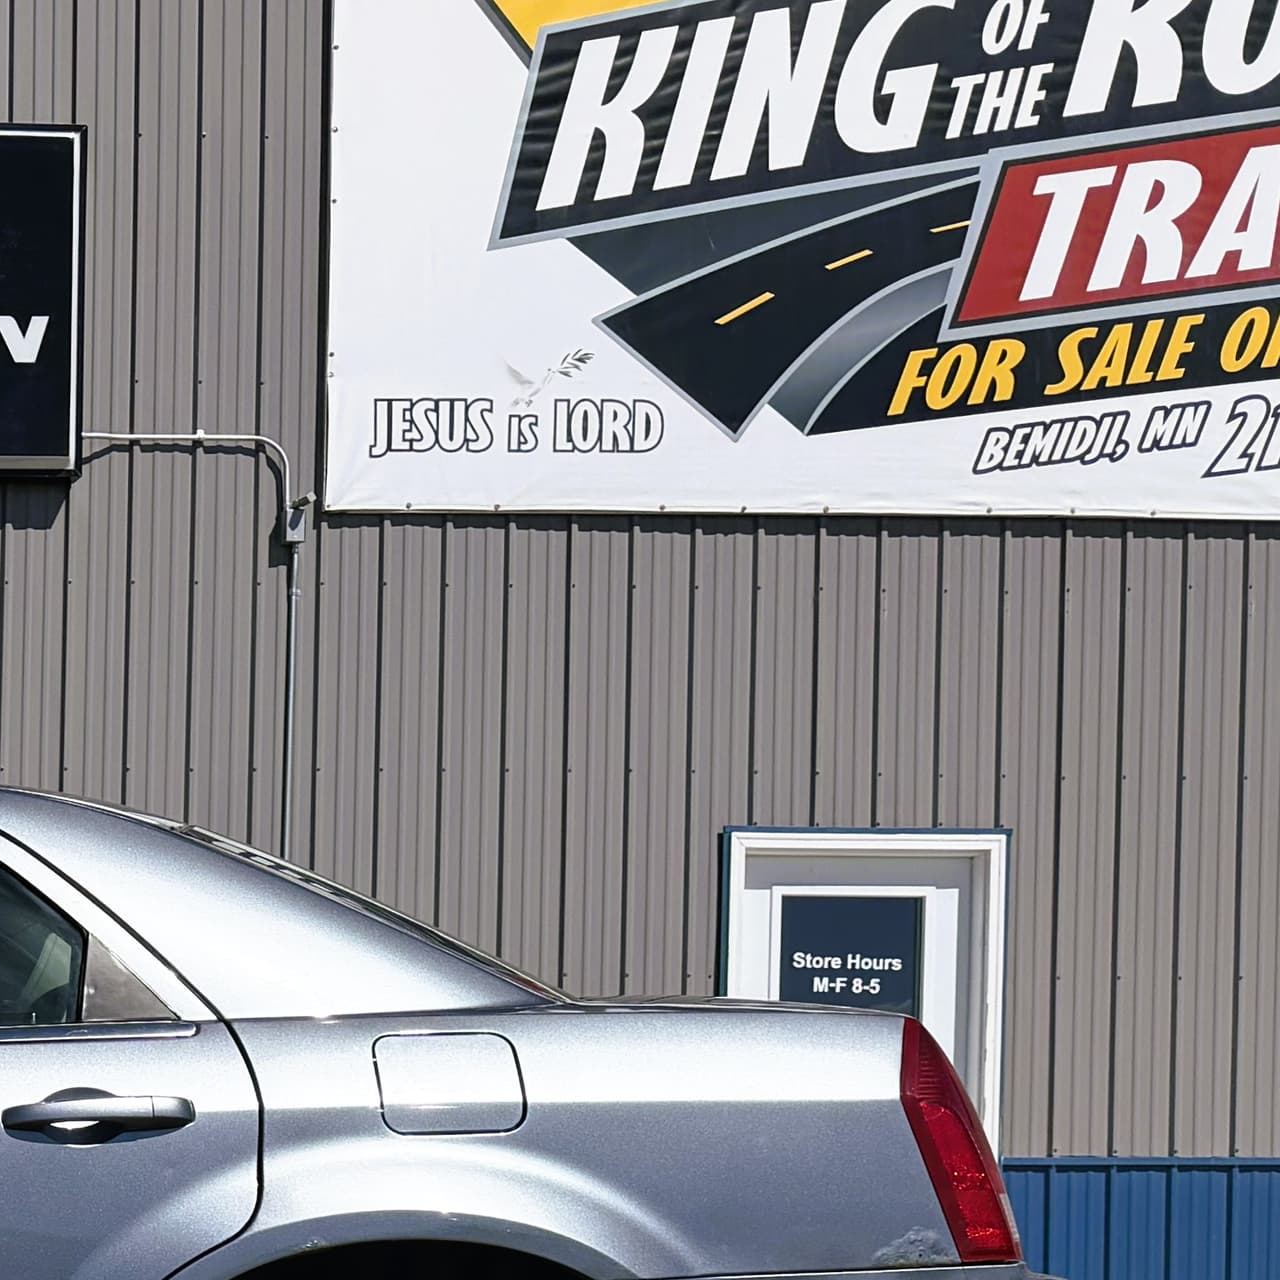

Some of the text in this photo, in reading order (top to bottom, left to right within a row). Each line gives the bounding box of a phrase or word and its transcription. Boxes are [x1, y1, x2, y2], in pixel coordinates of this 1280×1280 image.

[981, 0, 1050, 55] OF
[536, 0, 955, 211] KING
[945, 63, 1054, 140] THE
[1018, 144, 1280, 302] TRA
[887, 339, 1026, 417] FOR
[1044, 314, 1206, 396] SALE
[369, 398, 664, 458] JESUS IS LORD
[972, 410, 1132, 474] BEMIDJI,
[1137, 400, 1212, 454] MN
[792, 952, 903, 971] Store Hours
[813, 977, 881, 994] M-F 8-5
